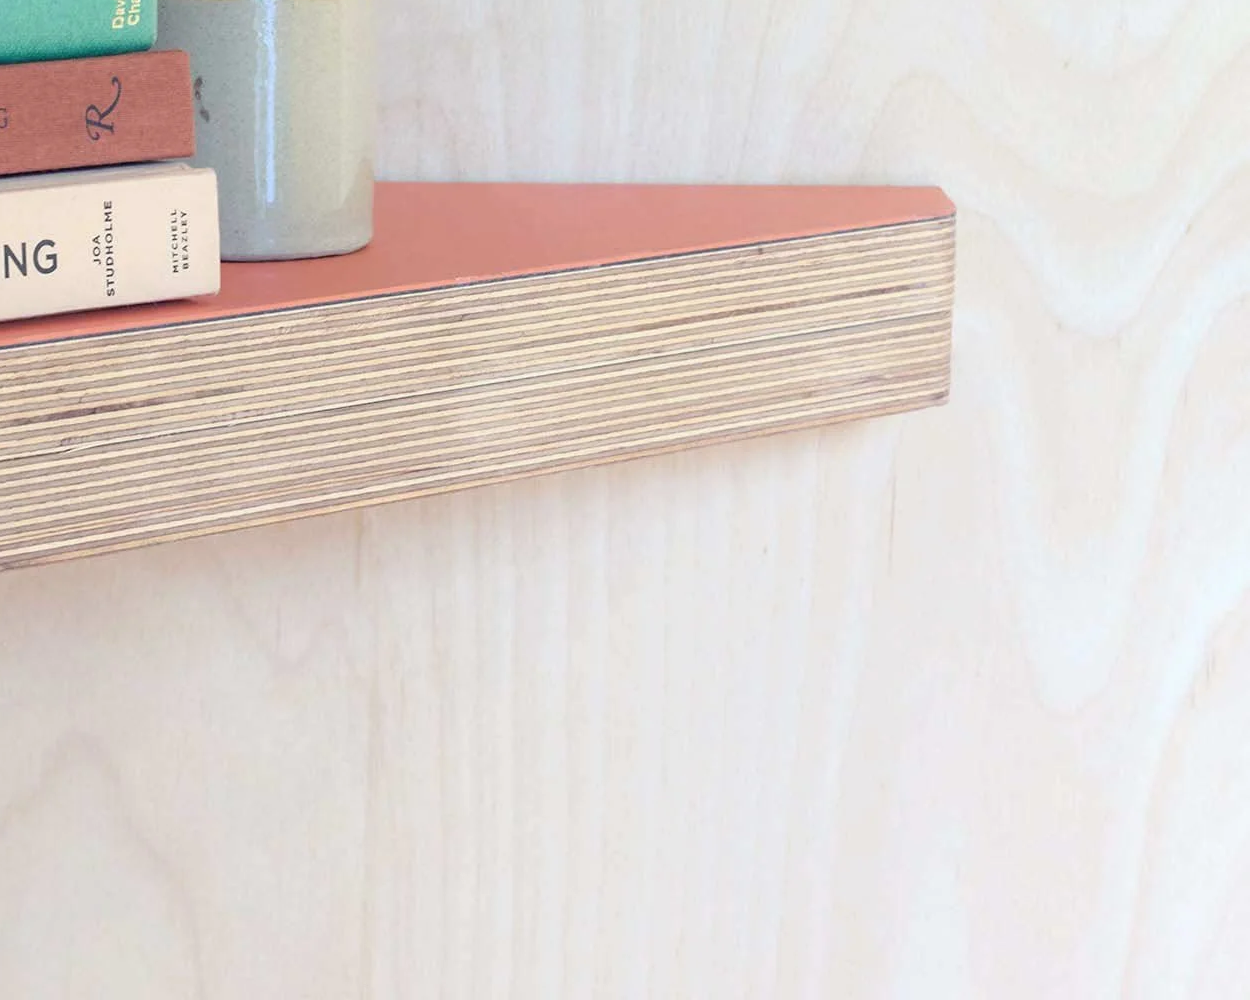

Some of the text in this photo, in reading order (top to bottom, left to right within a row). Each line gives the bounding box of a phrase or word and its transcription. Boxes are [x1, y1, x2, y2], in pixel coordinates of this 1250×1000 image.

[92, 234, 102, 265] JOA
[103, 200, 116, 297] STUDHOLME
[170, 209, 180, 274] MITCHELL
[180, 210, 190, 270] BEAZLEY
